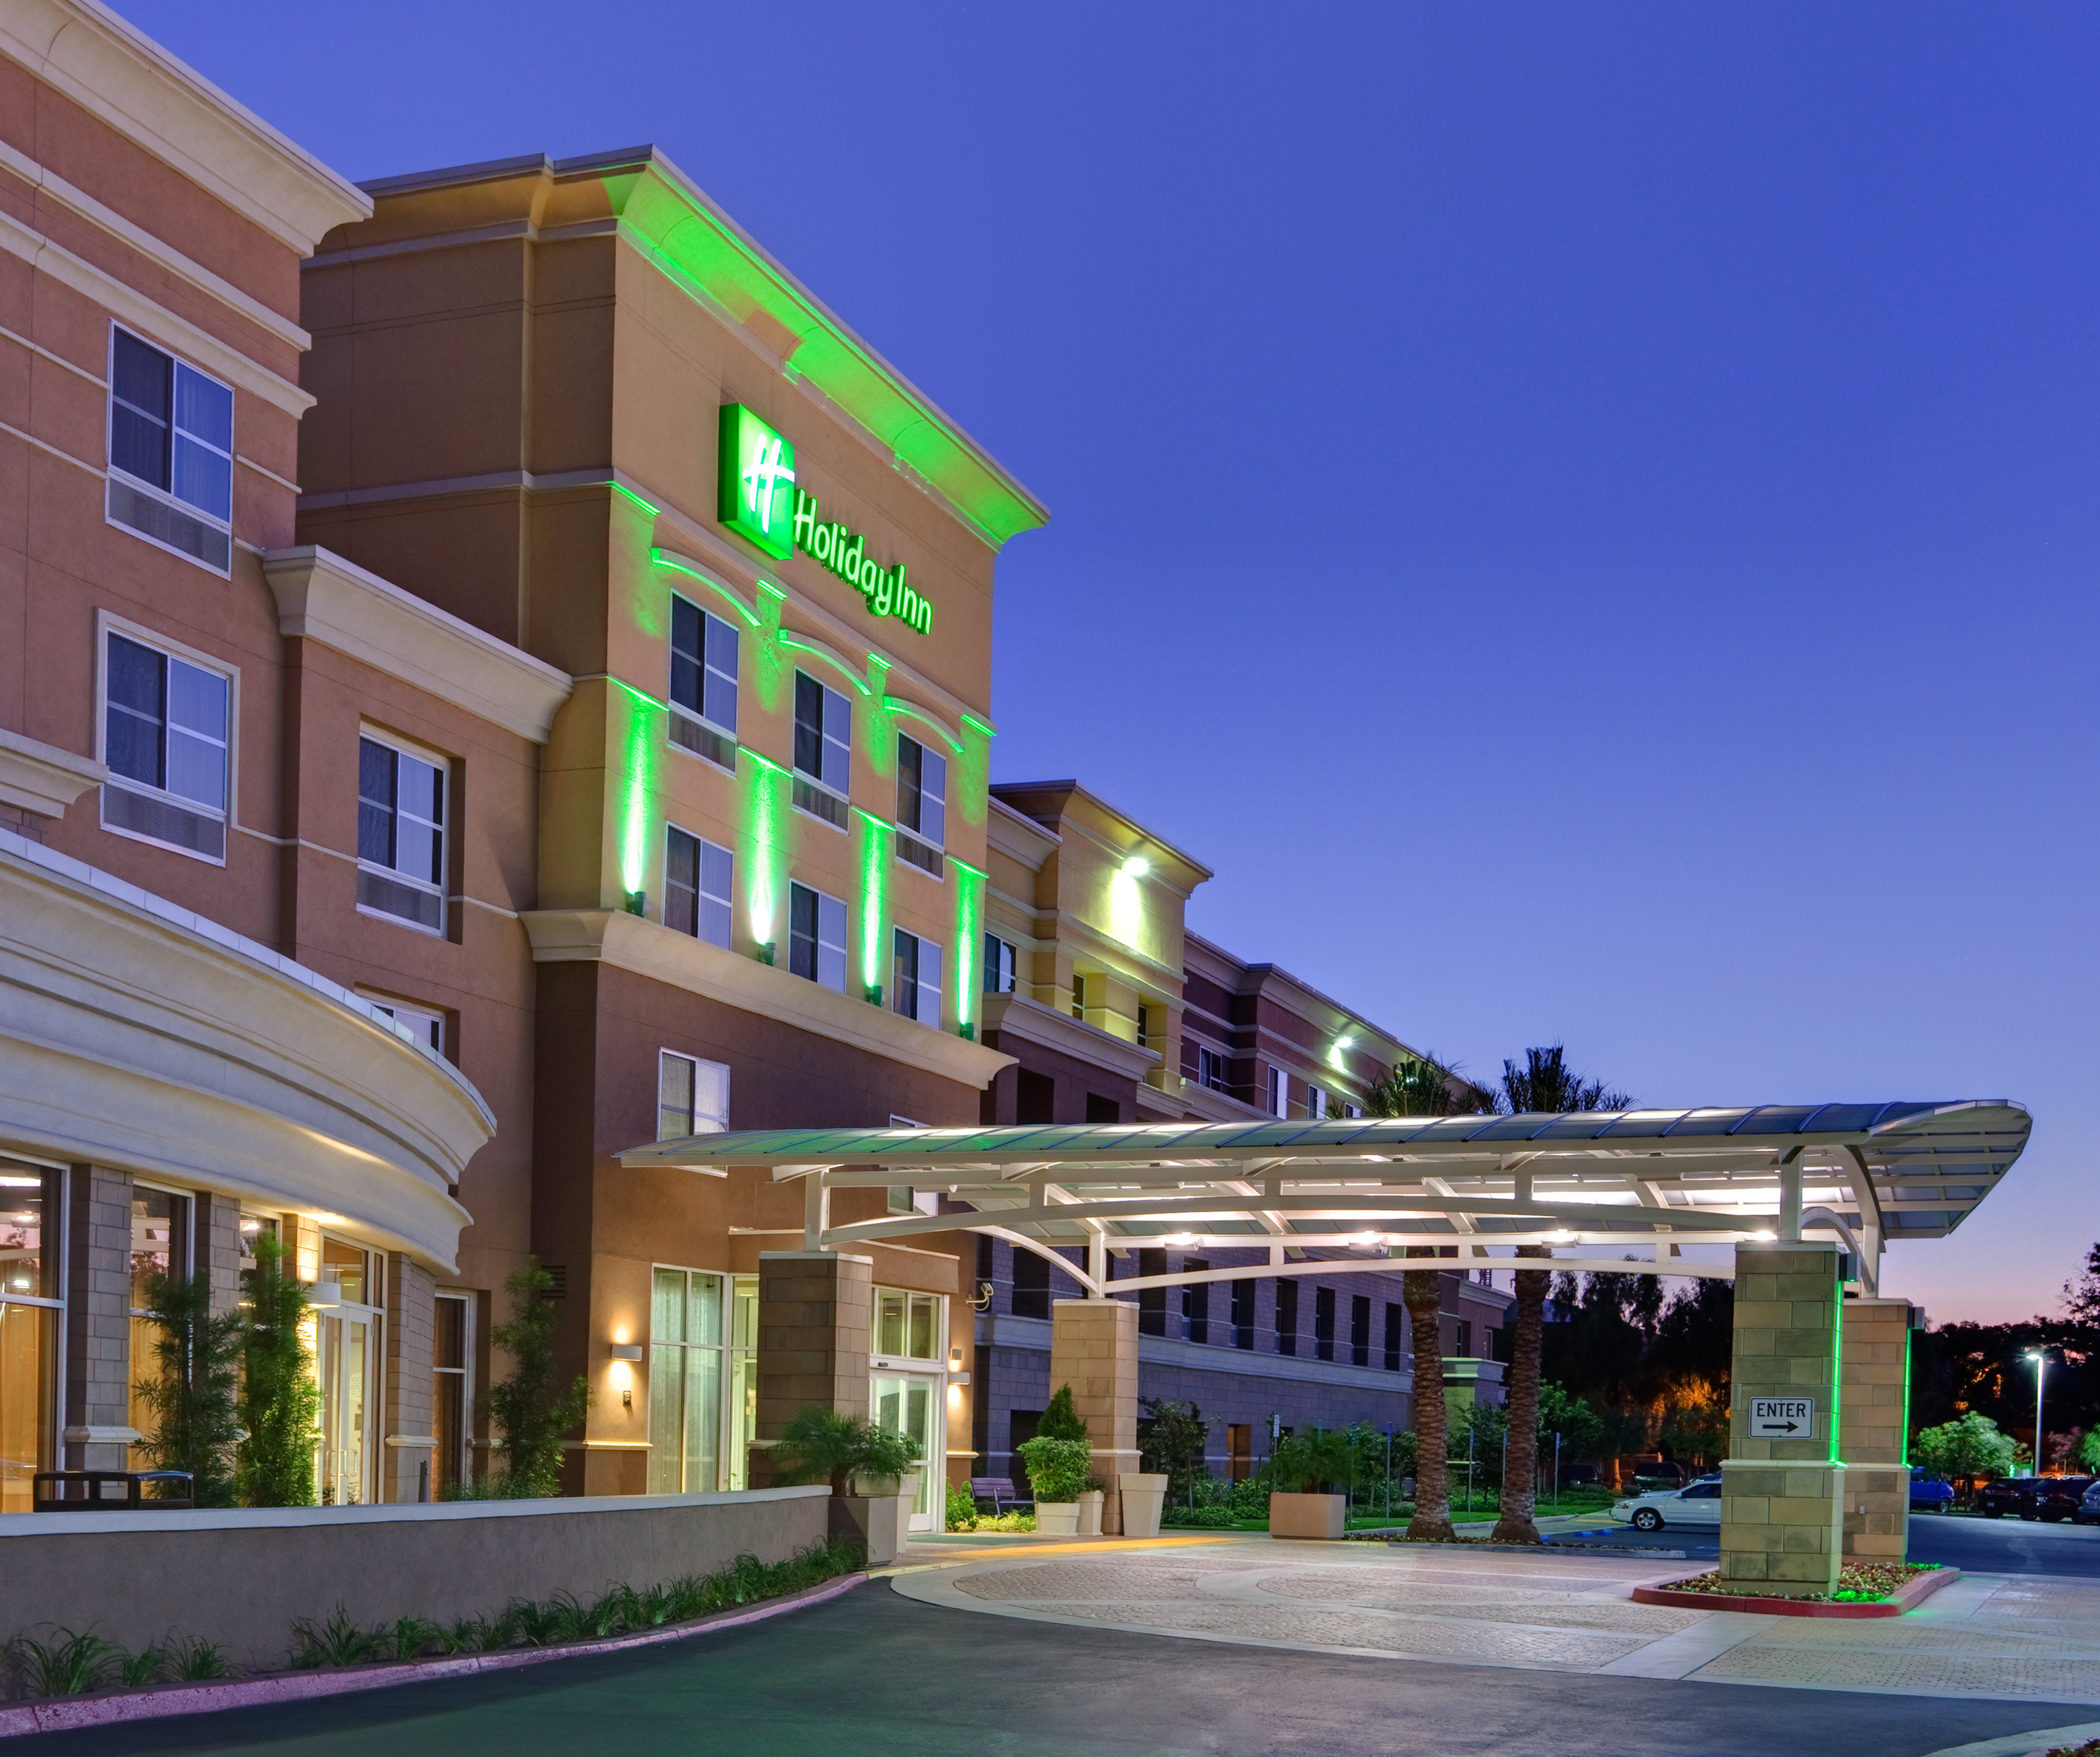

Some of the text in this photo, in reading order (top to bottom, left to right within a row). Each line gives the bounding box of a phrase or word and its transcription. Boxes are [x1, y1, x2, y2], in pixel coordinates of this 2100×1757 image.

[793, 488, 932, 635] Holiday Inn
[1757, 1403, 1806, 1417] ENTER
